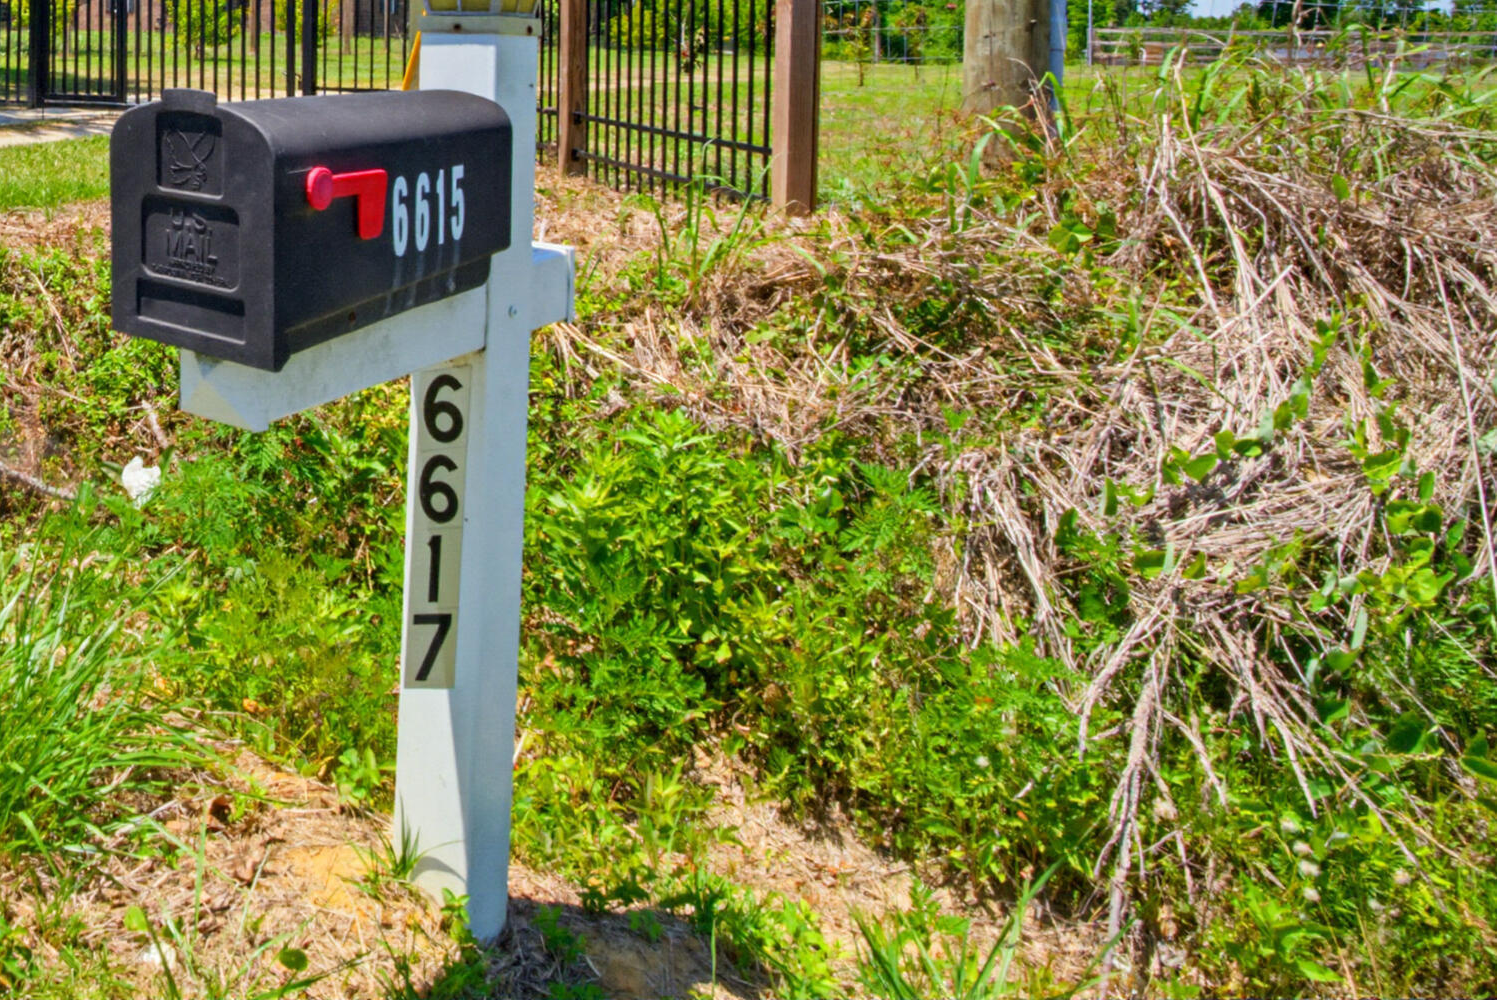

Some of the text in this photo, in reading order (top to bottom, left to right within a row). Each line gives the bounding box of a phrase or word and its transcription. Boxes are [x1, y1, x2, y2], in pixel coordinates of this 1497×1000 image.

[166, 229, 218, 264] MAIL
[392, 164, 466, 257] 6615
[412, 373, 464, 682] 6617
